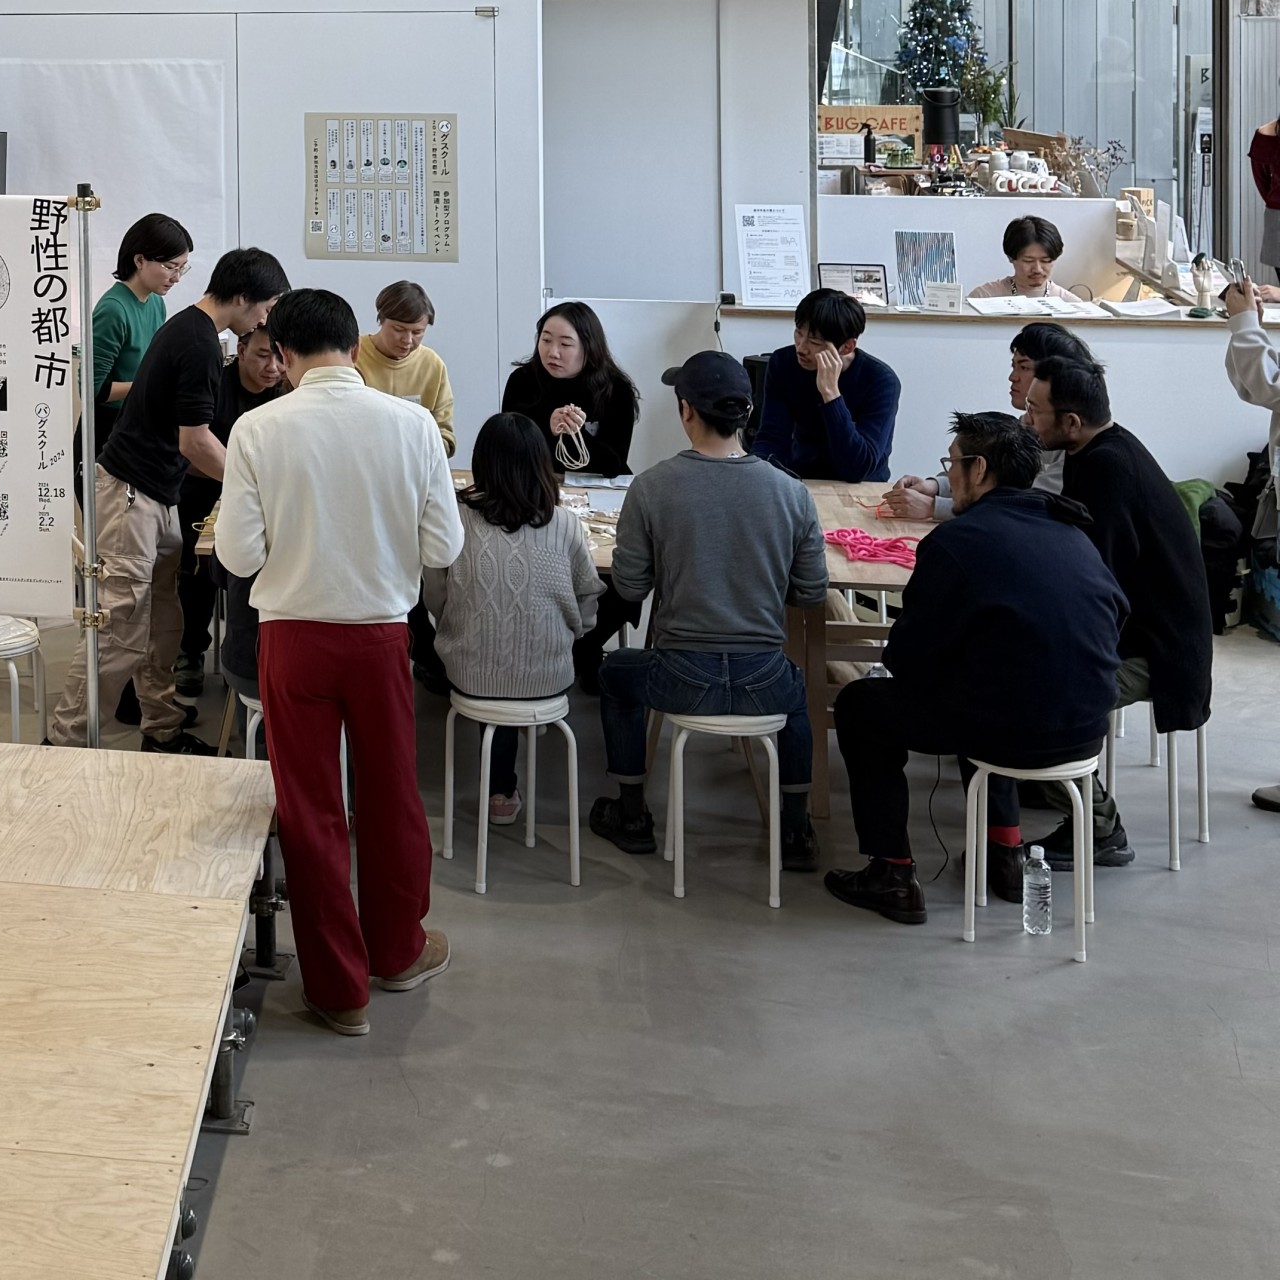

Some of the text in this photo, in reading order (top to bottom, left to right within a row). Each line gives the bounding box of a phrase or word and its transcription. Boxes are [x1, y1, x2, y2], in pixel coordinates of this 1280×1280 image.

[824, 117, 907, 131] BUG CAFE
[29, 198, 70, 389] 野性の都市
[35, 402, 51, 470] バグスクール
[38, 487, 66, 497] 12.18
[39, 517, 55, 527] 2.2
